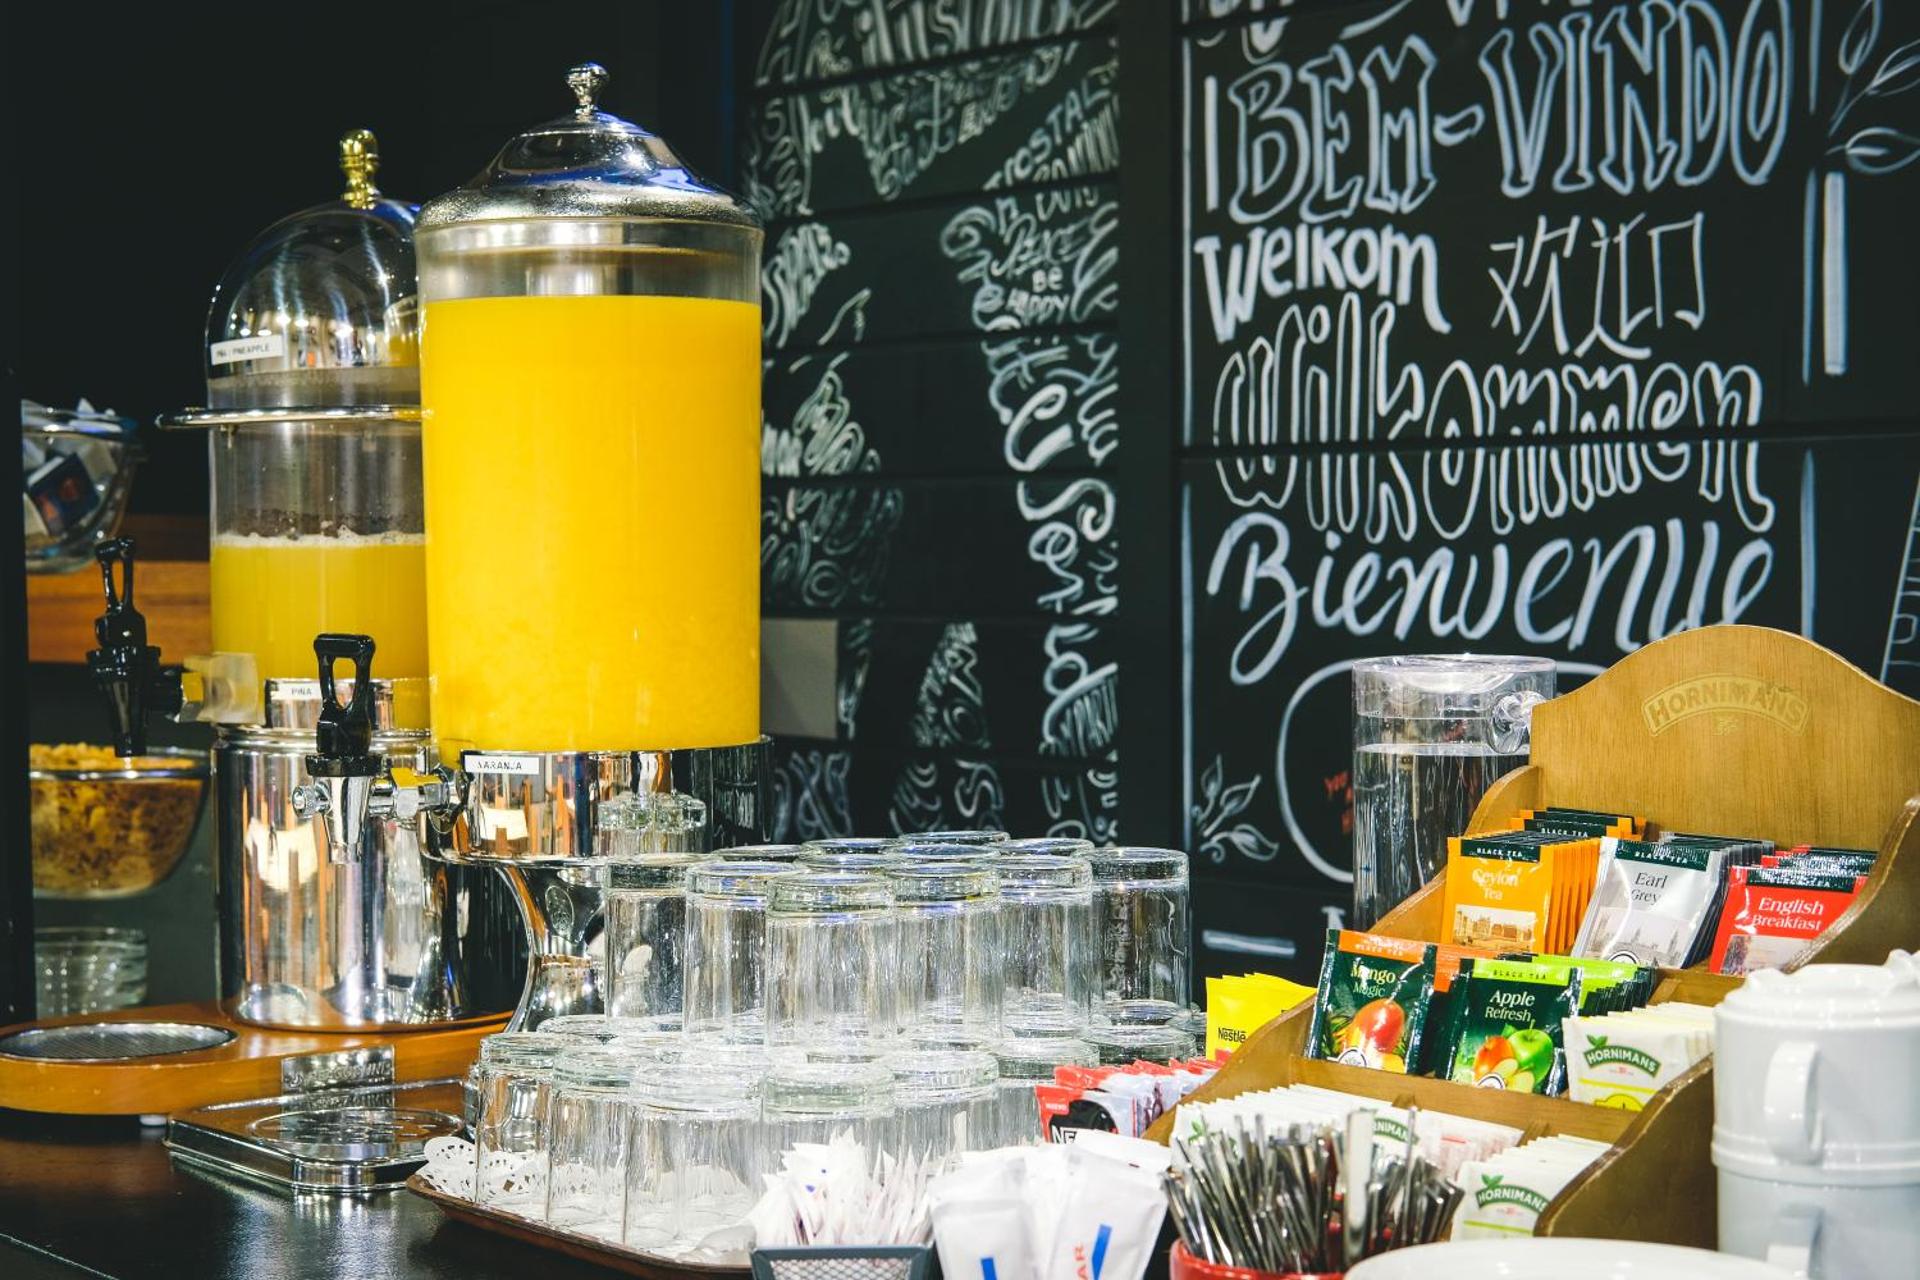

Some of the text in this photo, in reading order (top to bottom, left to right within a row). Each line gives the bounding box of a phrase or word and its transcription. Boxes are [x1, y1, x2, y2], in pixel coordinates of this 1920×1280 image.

[1229, 0, 1793, 225] BEM-VINDO
[1207, 511, 1774, 686] Bienvenue
[1476, 847, 1523, 858] BLACK TEA
[1634, 851, 1688, 864] BLACK TEA
[1472, 868, 1519, 887] Ceylon
[1635, 872, 1668, 888] Earl
[1484, 888, 1503, 900] Tea
[1631, 889, 1661, 905] Grey
[1758, 897, 1825, 916] English
[1751, 914, 1823, 931] Breakfast
[1351, 960, 1396, 985] Mngo
[1493, 969, 1523, 978] BLACK
[1489, 989, 1536, 1008] Apple
[1484, 1005, 1532, 1022] Refresh
[1586, 1048, 1657, 1073] HORNIMANS
[1478, 1187, 1550, 1210] HORNIMANS
